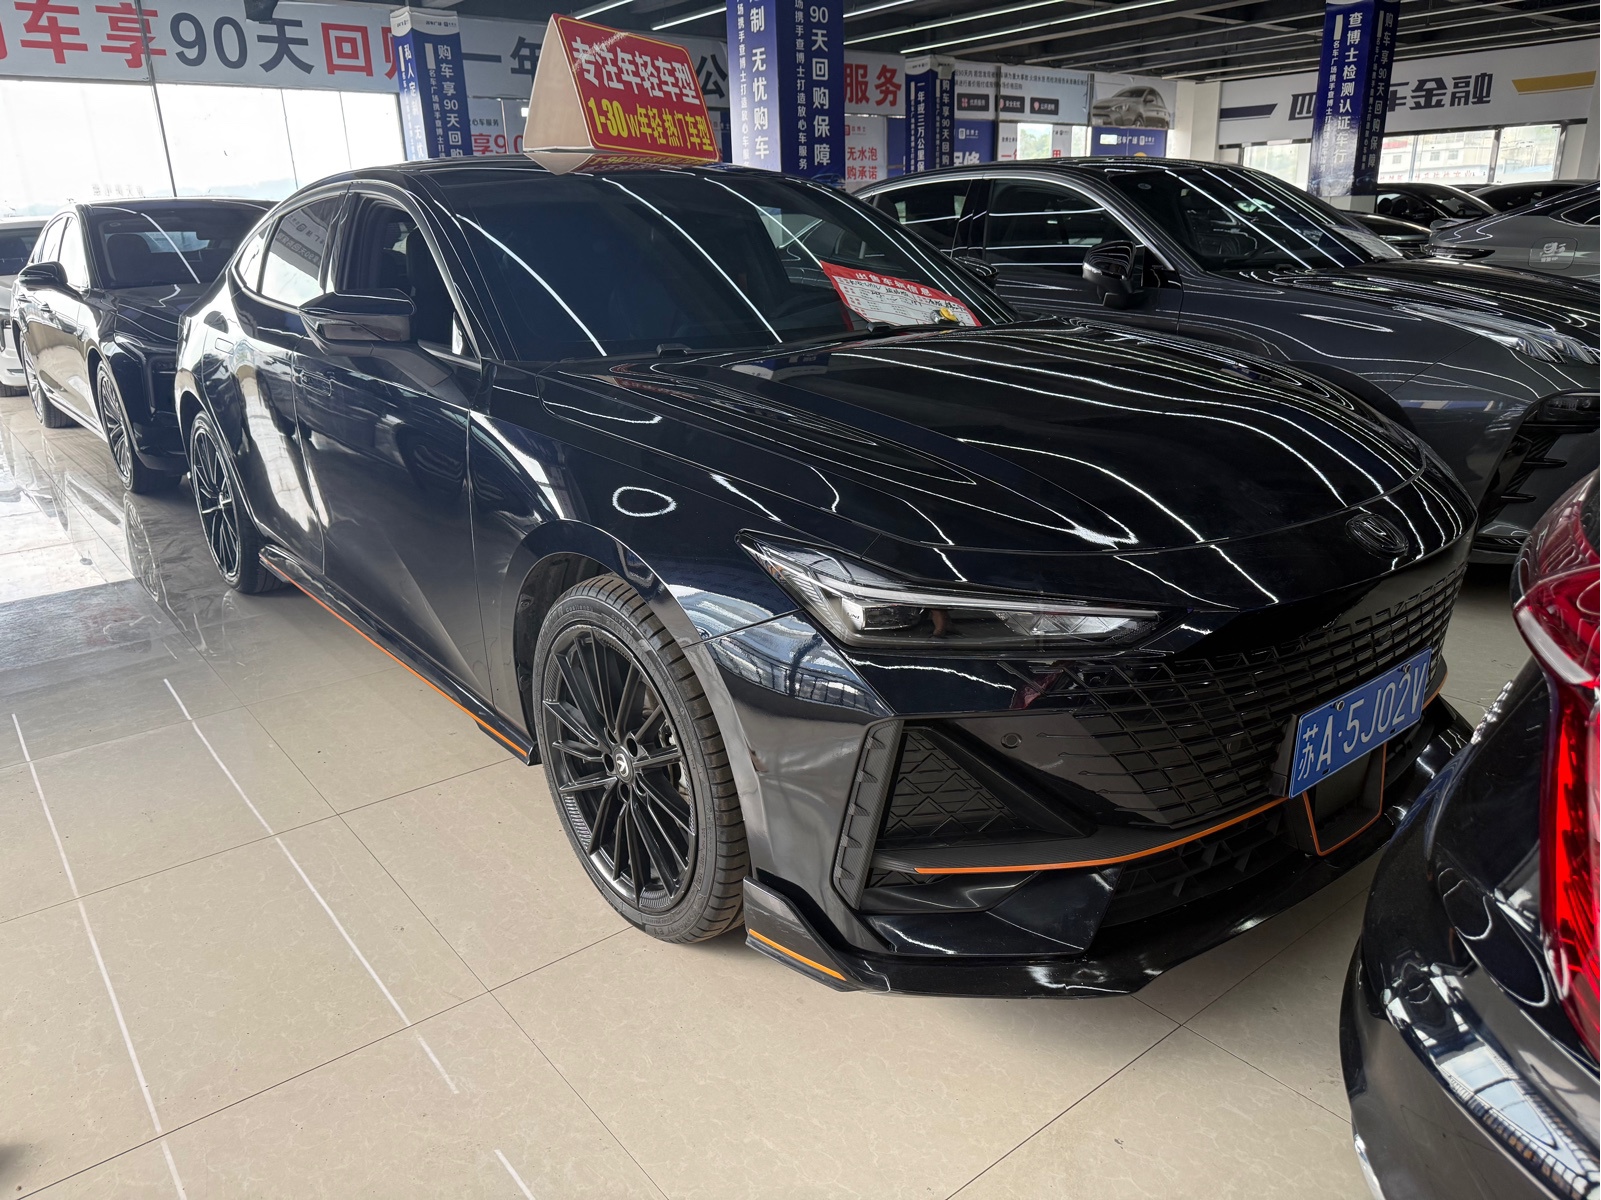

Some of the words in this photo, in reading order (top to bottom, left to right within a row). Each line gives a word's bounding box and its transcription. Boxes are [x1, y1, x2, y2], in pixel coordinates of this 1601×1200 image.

[0, 0, 398, 81] 车享90天回
[750, 0, 765, 33] 制
[571, 36, 701, 106] 专注年轻车型
[737, 0, 751, 166] 场携手查博士打造放心车服
[751, 47, 770, 160] 无忧购车
[809, 5, 831, 167] 90天回购保障
[843, 63, 902, 107] 服务
[1333, 12, 1363, 164] 查博士检测认证车行
[1367, 12, 1394, 168] 购车享90天回购保障
[469, 118, 499, 127] 心车服务
[846, 146, 878, 161] 无水泡
[846, 166, 878, 180] 购承诺
[855, 272, 933, 297] 出售车辆信息
